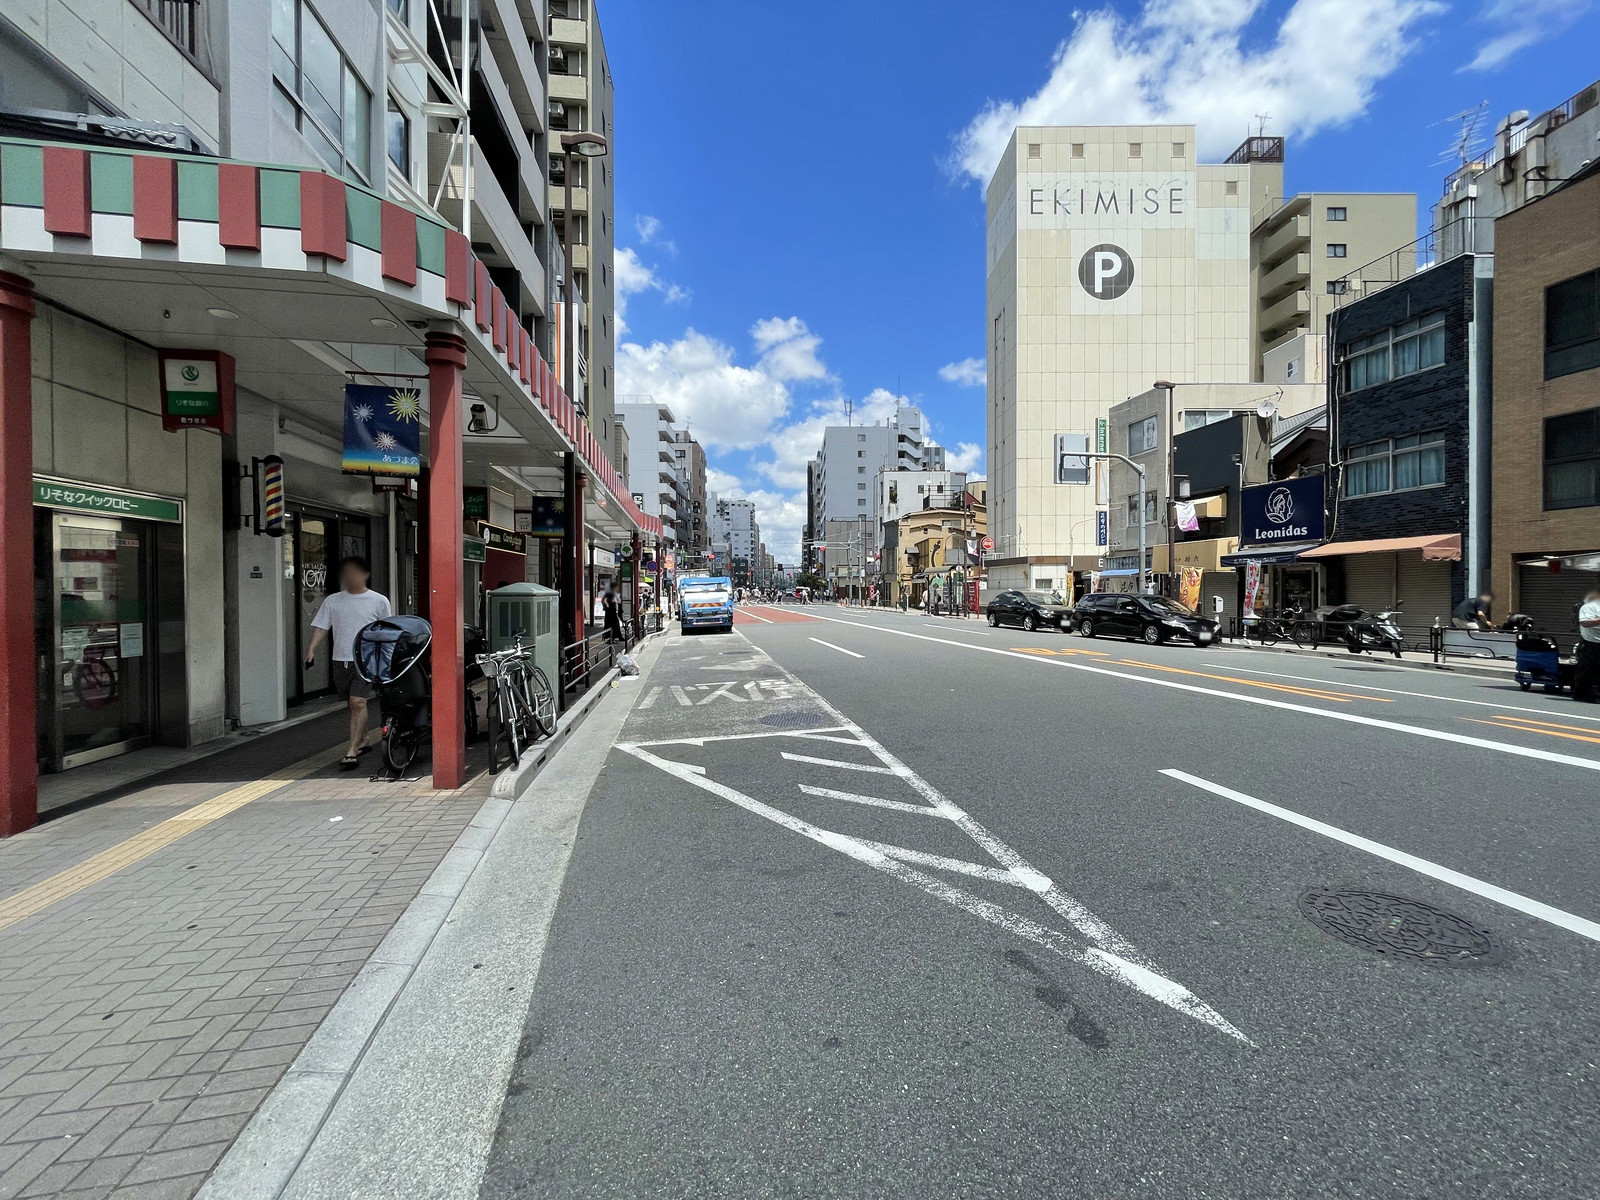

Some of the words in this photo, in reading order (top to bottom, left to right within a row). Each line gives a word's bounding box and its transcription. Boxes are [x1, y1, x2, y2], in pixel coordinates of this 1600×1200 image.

[1030, 188, 1183, 215] EKIMISE
[1094, 251, 1123, 293] P
[40, 486, 139, 511] りそなクイックロビー
[1255, 524, 1308, 540] Leonidas
